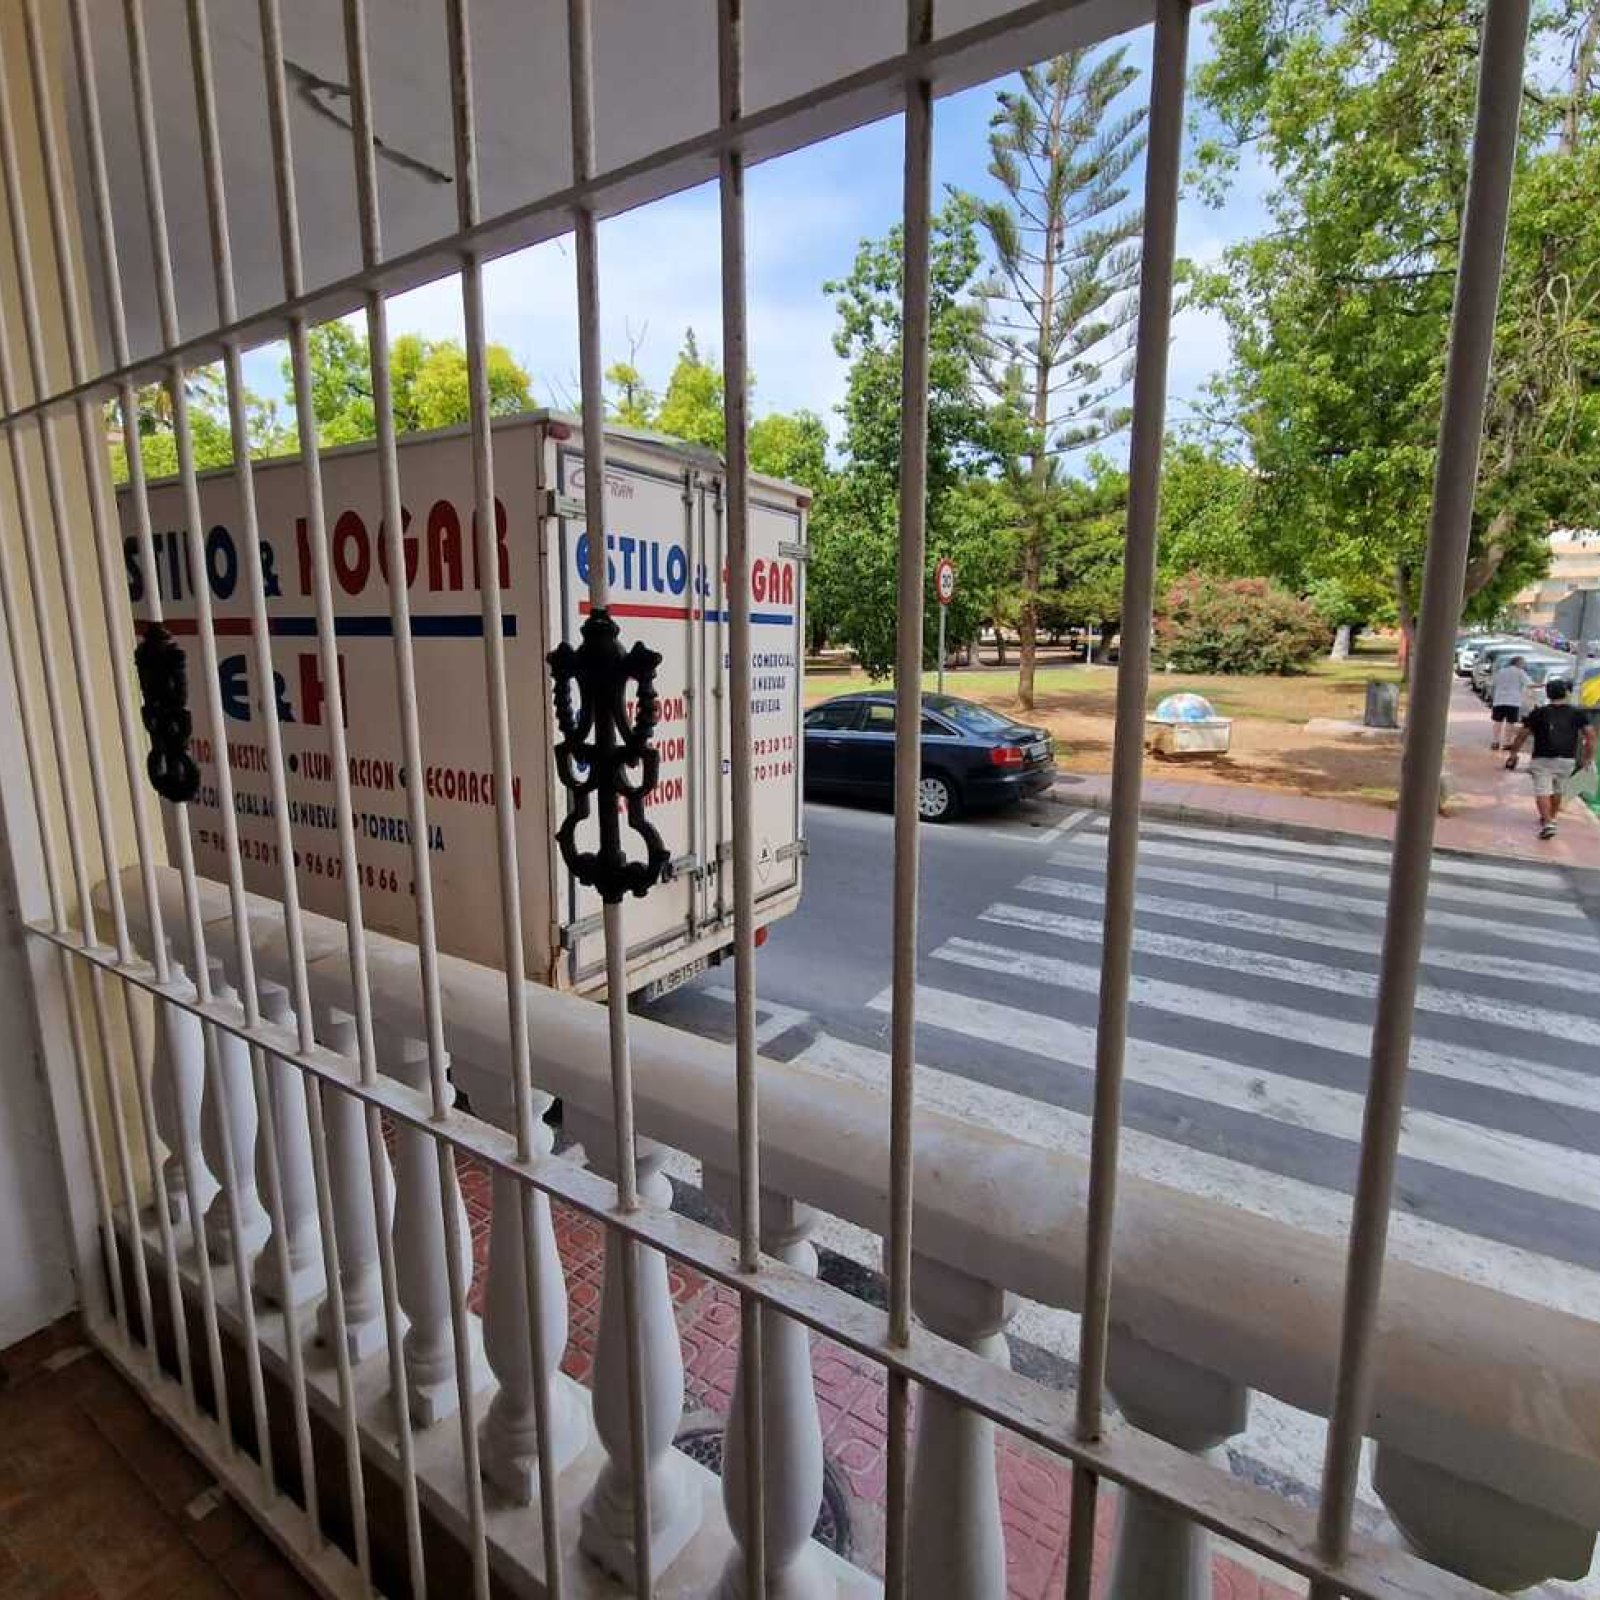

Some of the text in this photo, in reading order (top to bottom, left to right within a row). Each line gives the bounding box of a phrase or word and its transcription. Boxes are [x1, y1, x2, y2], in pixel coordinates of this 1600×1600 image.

[258, 539, 282, 597] &
[694, 563, 710, 597] &
[723, 555, 793, 605] GAR
[426, 766, 521, 810] ECORACIN
[361, 813, 445, 851] TORREVJA
